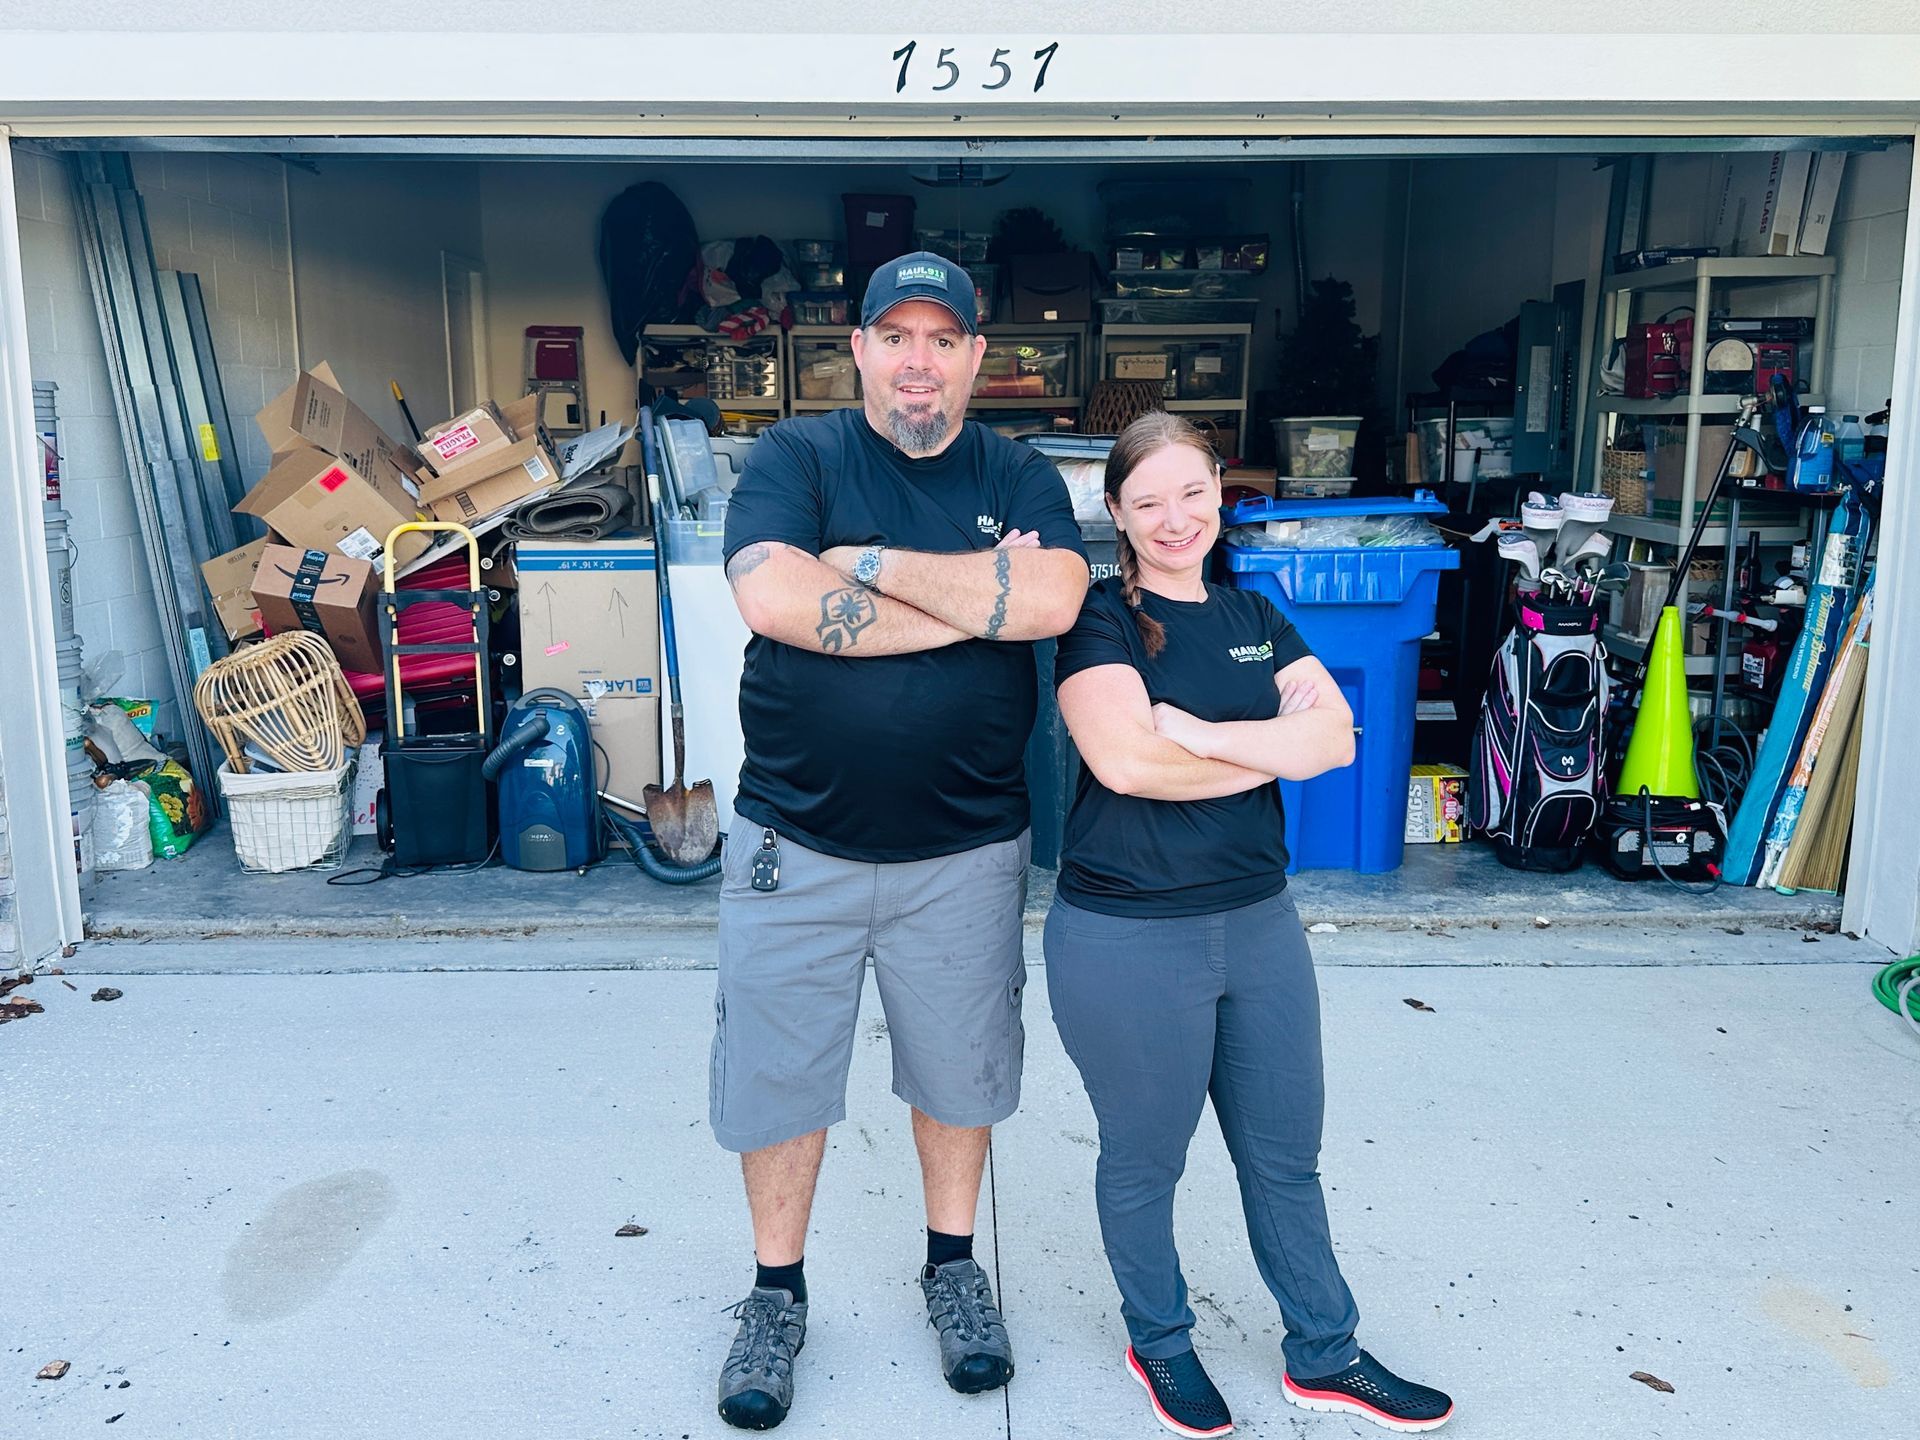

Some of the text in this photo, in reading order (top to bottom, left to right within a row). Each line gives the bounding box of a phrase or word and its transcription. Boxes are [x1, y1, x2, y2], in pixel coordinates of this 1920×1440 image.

[898, 266, 945, 279] HAUL911
[438, 430, 472, 453] FRAGILE
[1228, 640, 1273, 658] HAUL91
[1792, 649, 1804, 680] WEEKEND
[582, 680, 633, 693] LARE
[1407, 783, 1424, 838] RAGS
[1445, 801, 1457, 820] 300
